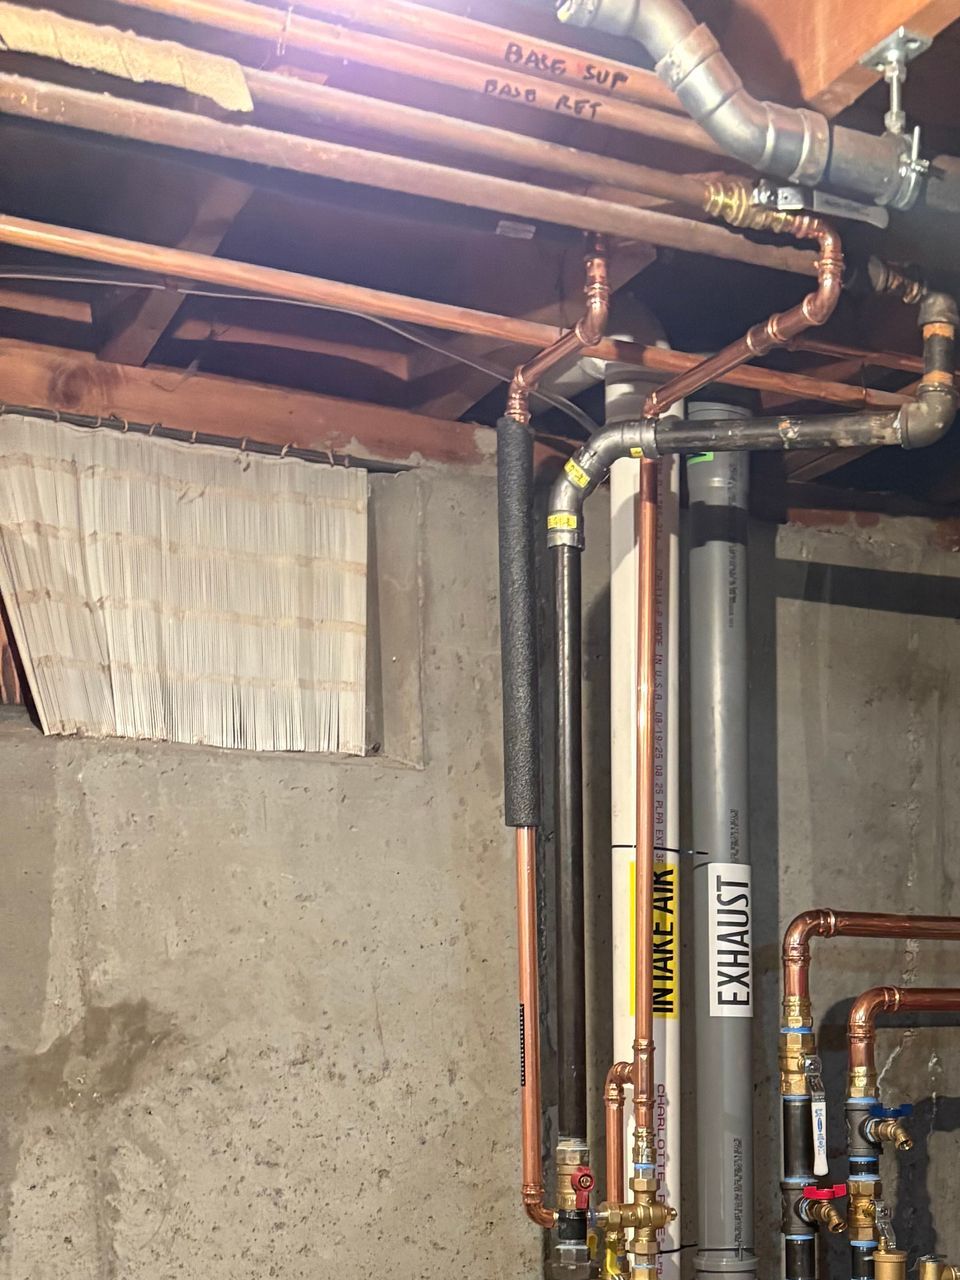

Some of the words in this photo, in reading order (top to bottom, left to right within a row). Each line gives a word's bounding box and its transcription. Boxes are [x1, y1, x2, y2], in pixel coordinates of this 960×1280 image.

[504, 42, 567, 76] BASE
[583, 63, 629, 91] SUP
[555, 95, 602, 119] RET
[655, 711, 664, 760] 08/19/25
[655, 829, 664, 847] EXT
[716, 874, 750, 1006] EXHAUST
[656, 1083, 665, 1182] CHARLOTTE
